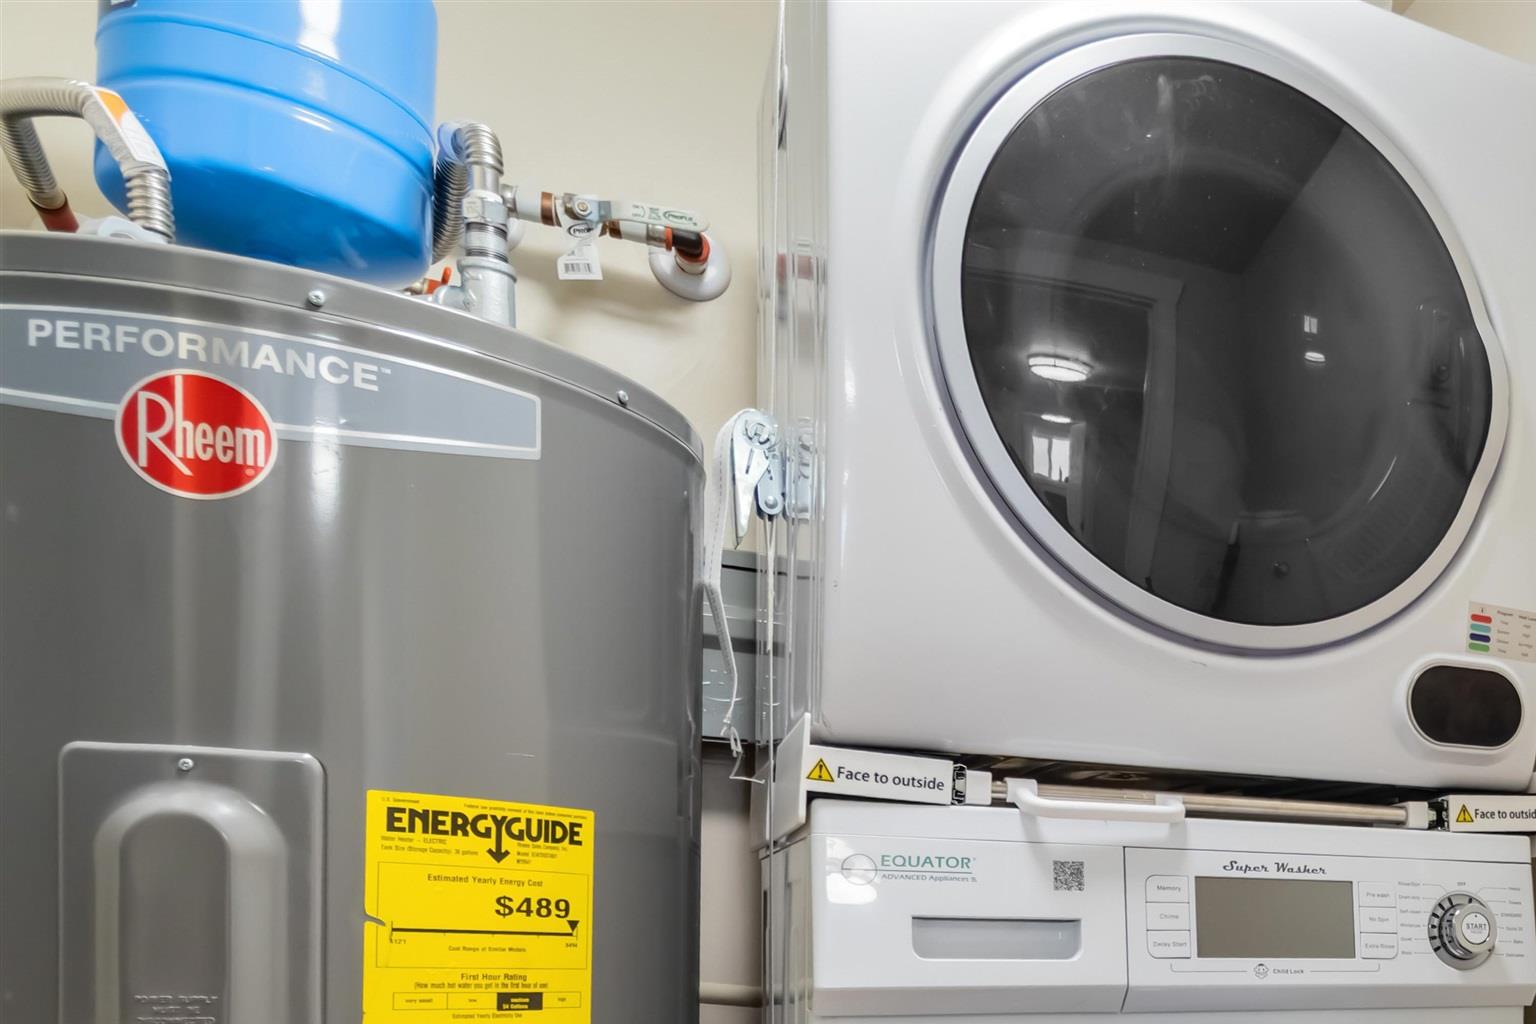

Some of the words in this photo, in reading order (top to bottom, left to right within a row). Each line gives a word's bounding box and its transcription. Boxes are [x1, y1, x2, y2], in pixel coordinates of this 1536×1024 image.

[138, 375, 266, 476] Rheem
[837, 766, 870, 782] Face
[874, 773, 888, 784] to
[892, 774, 945, 790] outside
[1474, 808, 1496, 819] Face
[1498, 809, 1508, 819] to
[386, 806, 583, 846] ENERGYGUIDE
[880, 854, 971, 869] EQUATOR
[1222, 860, 1269, 874] Super
[1274, 862, 1328, 875] Washer
[427, 874, 468, 883] Estimated
[472, 875, 496, 886] Yearly
[500, 877, 526, 888] Energy
[527, 879, 543, 887] Cost
[882, 873, 926, 881] ADVANCED
[1156, 884, 1181, 892] Memory
[495, 895, 570, 918] $489
[504, 974, 528, 982] Rating
